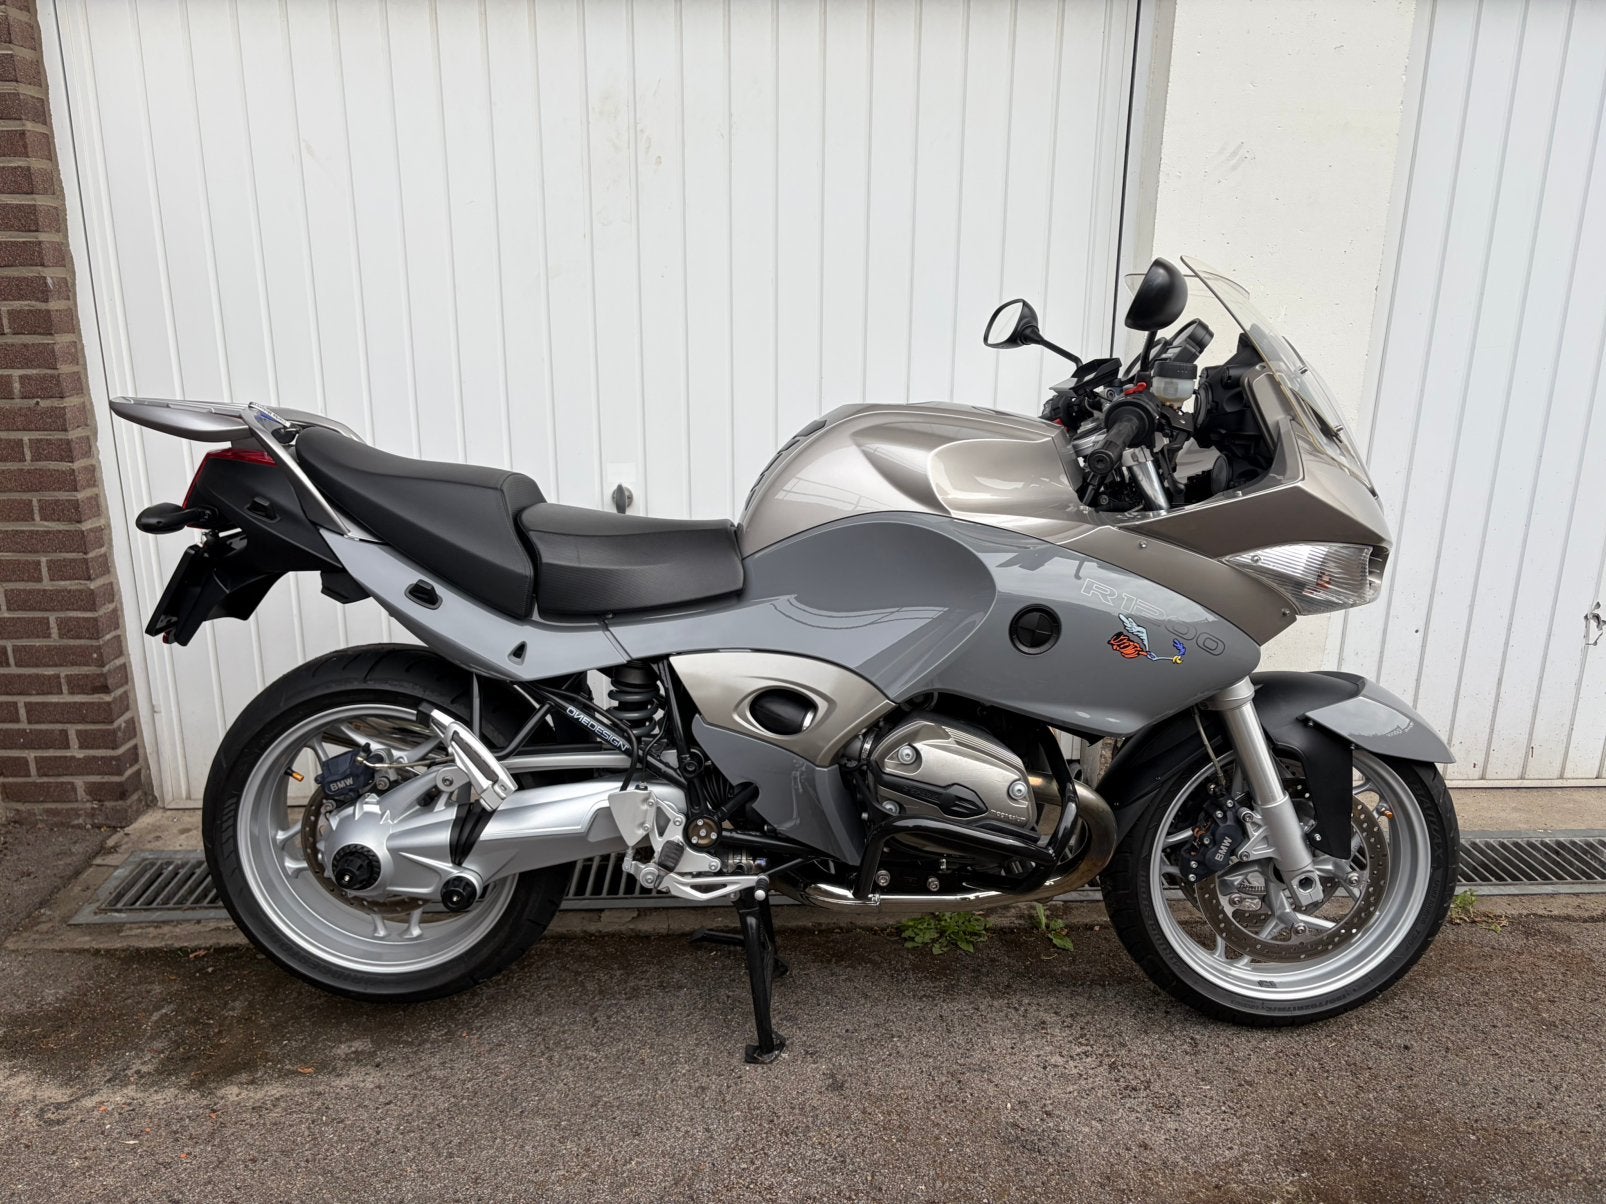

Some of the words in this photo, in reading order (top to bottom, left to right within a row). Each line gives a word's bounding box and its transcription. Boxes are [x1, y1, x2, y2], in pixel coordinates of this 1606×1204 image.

[566, 706, 629, 751] ONEDESIGN
[329, 777, 354, 791] BMW
[1214, 836, 1233, 862] BMW
